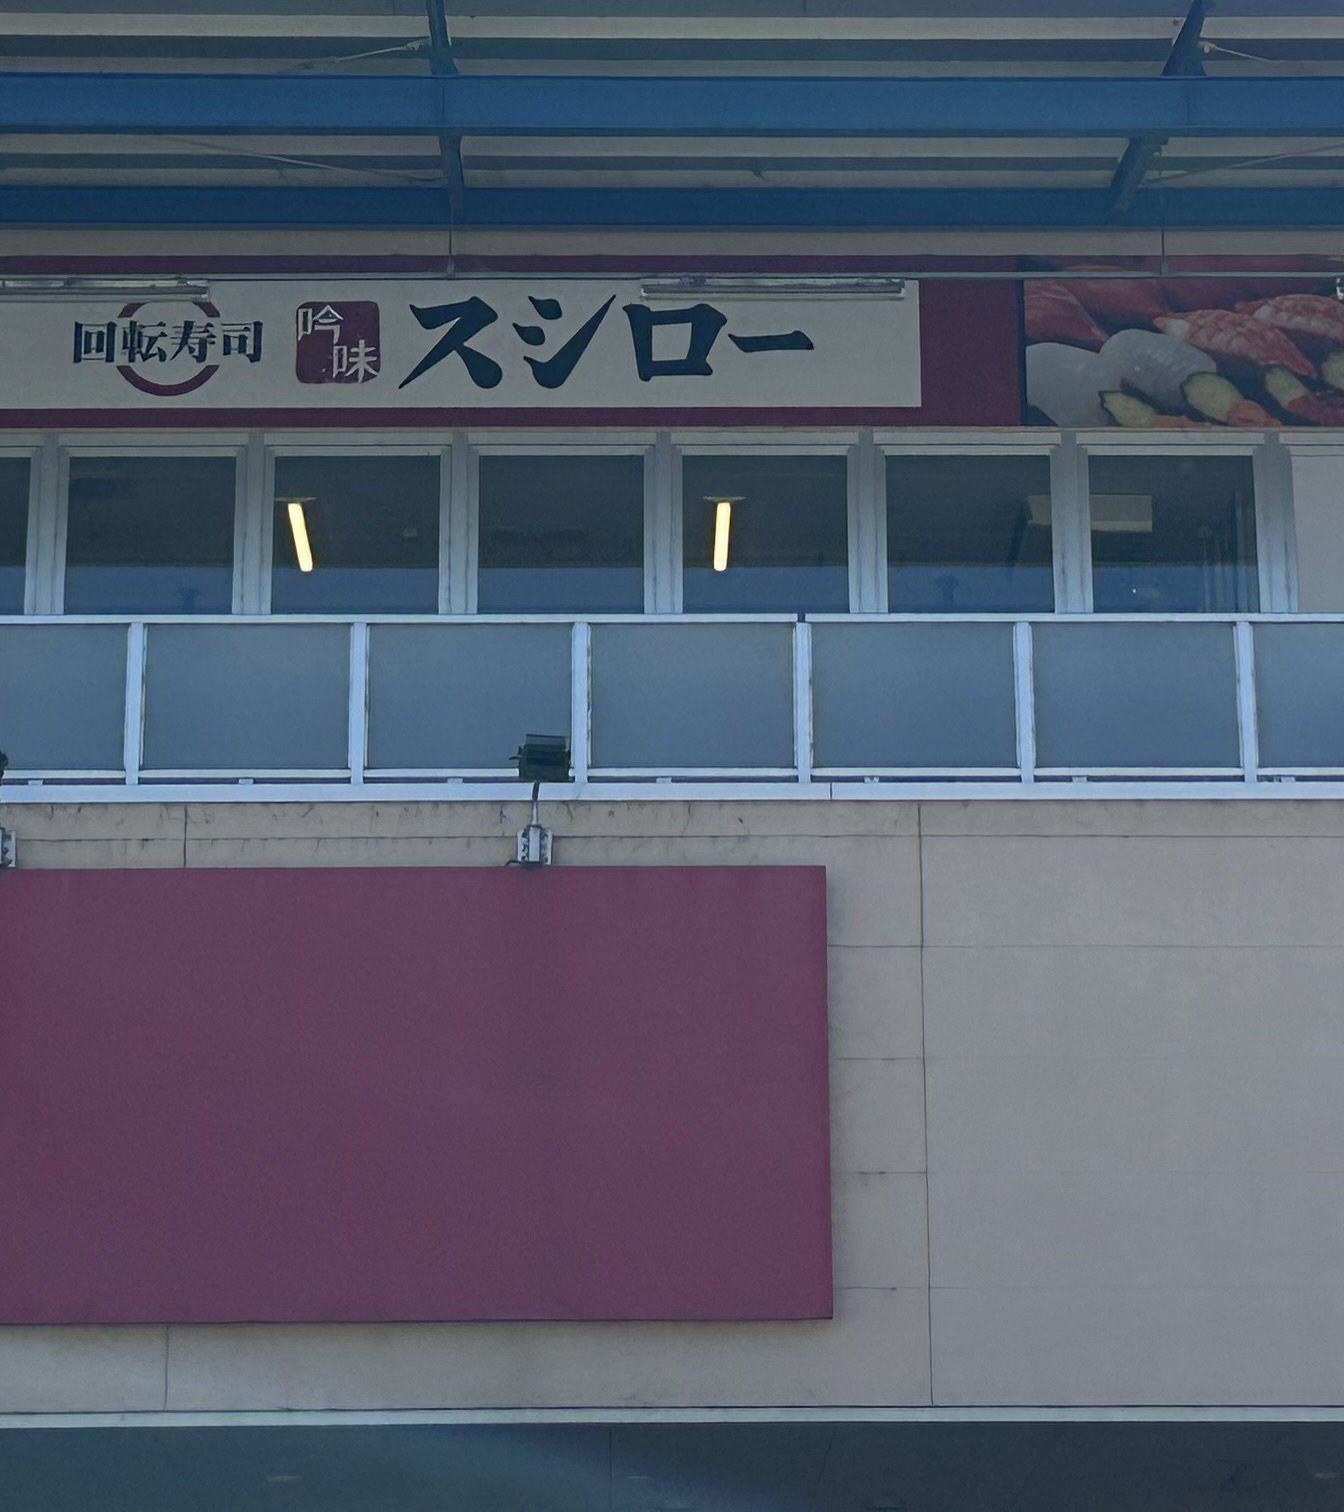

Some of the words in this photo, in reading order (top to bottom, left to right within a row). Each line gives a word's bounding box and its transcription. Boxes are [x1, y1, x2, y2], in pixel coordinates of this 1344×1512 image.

[72, 319, 264, 364] 回転寿司
[297, 304, 379, 384] 吟味
[398, 293, 815, 390] スシロー
